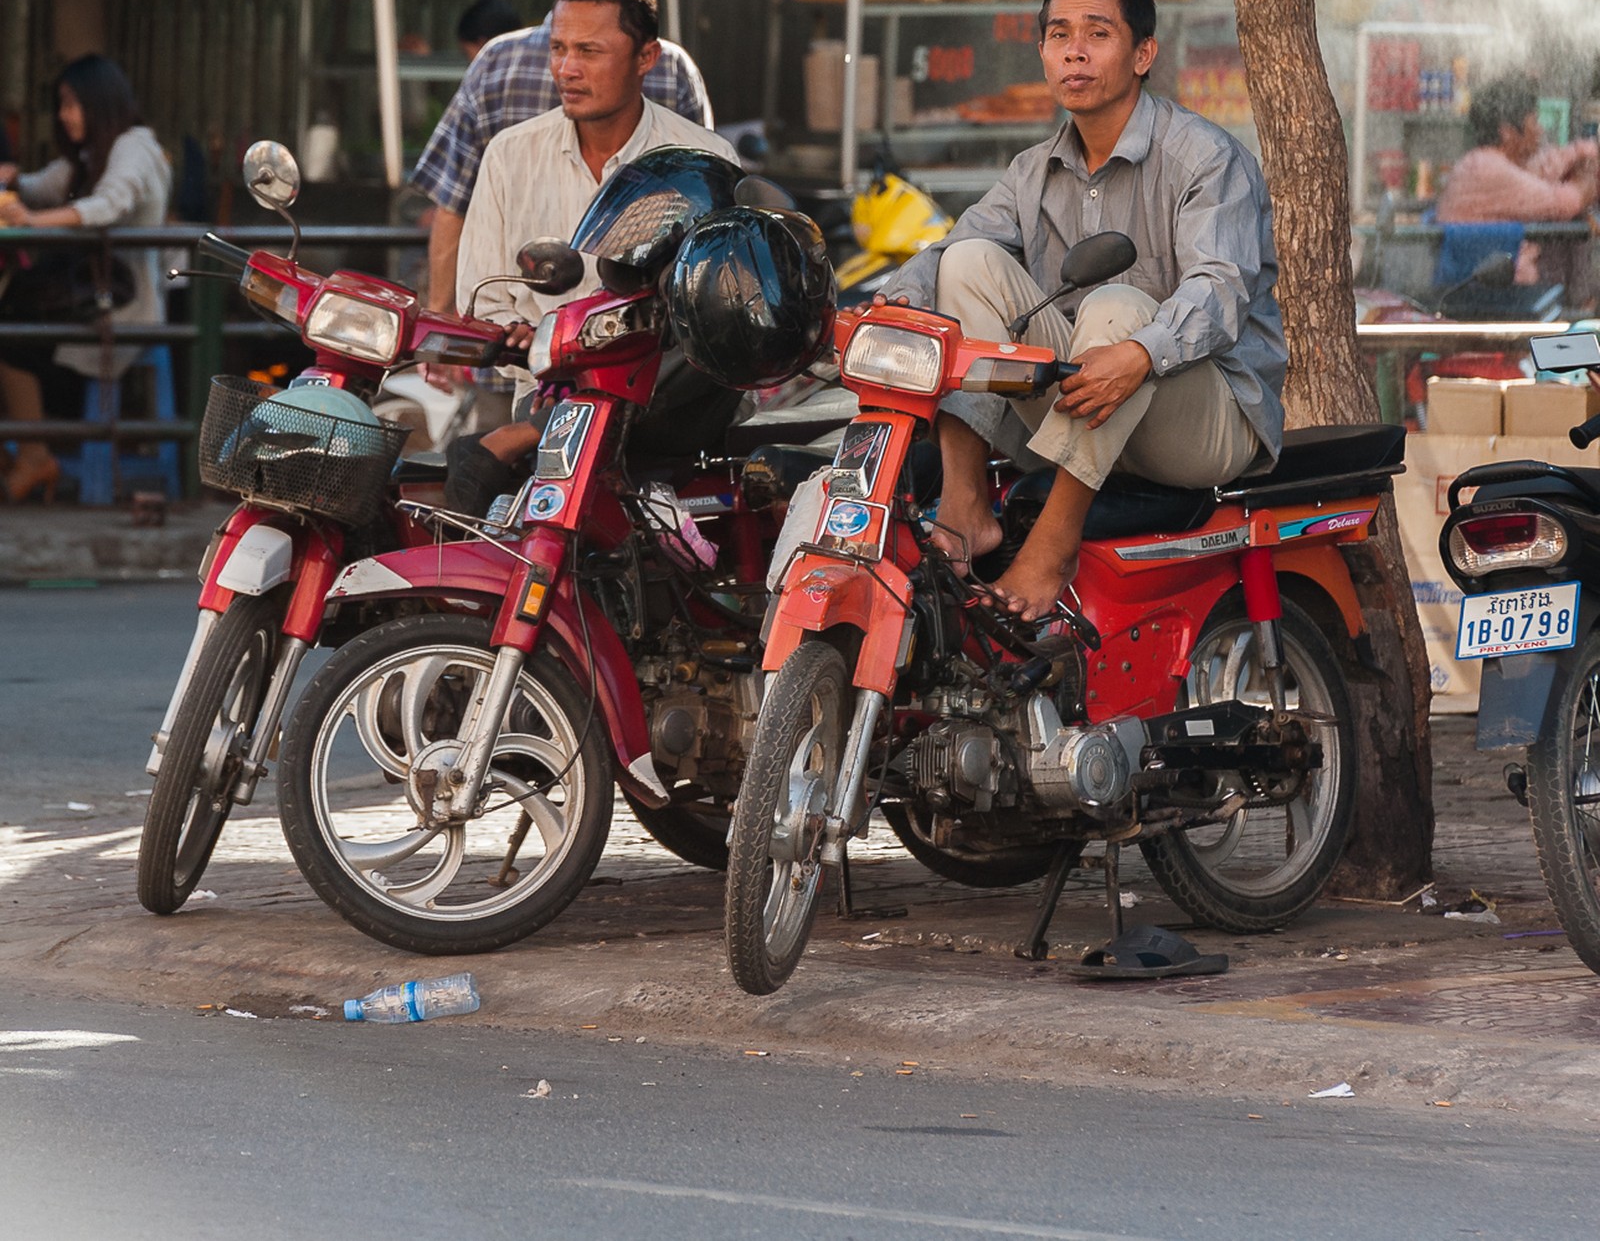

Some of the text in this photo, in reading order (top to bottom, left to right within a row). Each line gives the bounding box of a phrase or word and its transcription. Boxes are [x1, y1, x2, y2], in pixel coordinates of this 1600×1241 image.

[1472, 501, 1517, 515] SUZUKI
[1328, 516, 1361, 531] Deluxe
[1467, 609, 1570, 647] 1B-0798
[1479, 639, 1548, 654] PREY VENG
